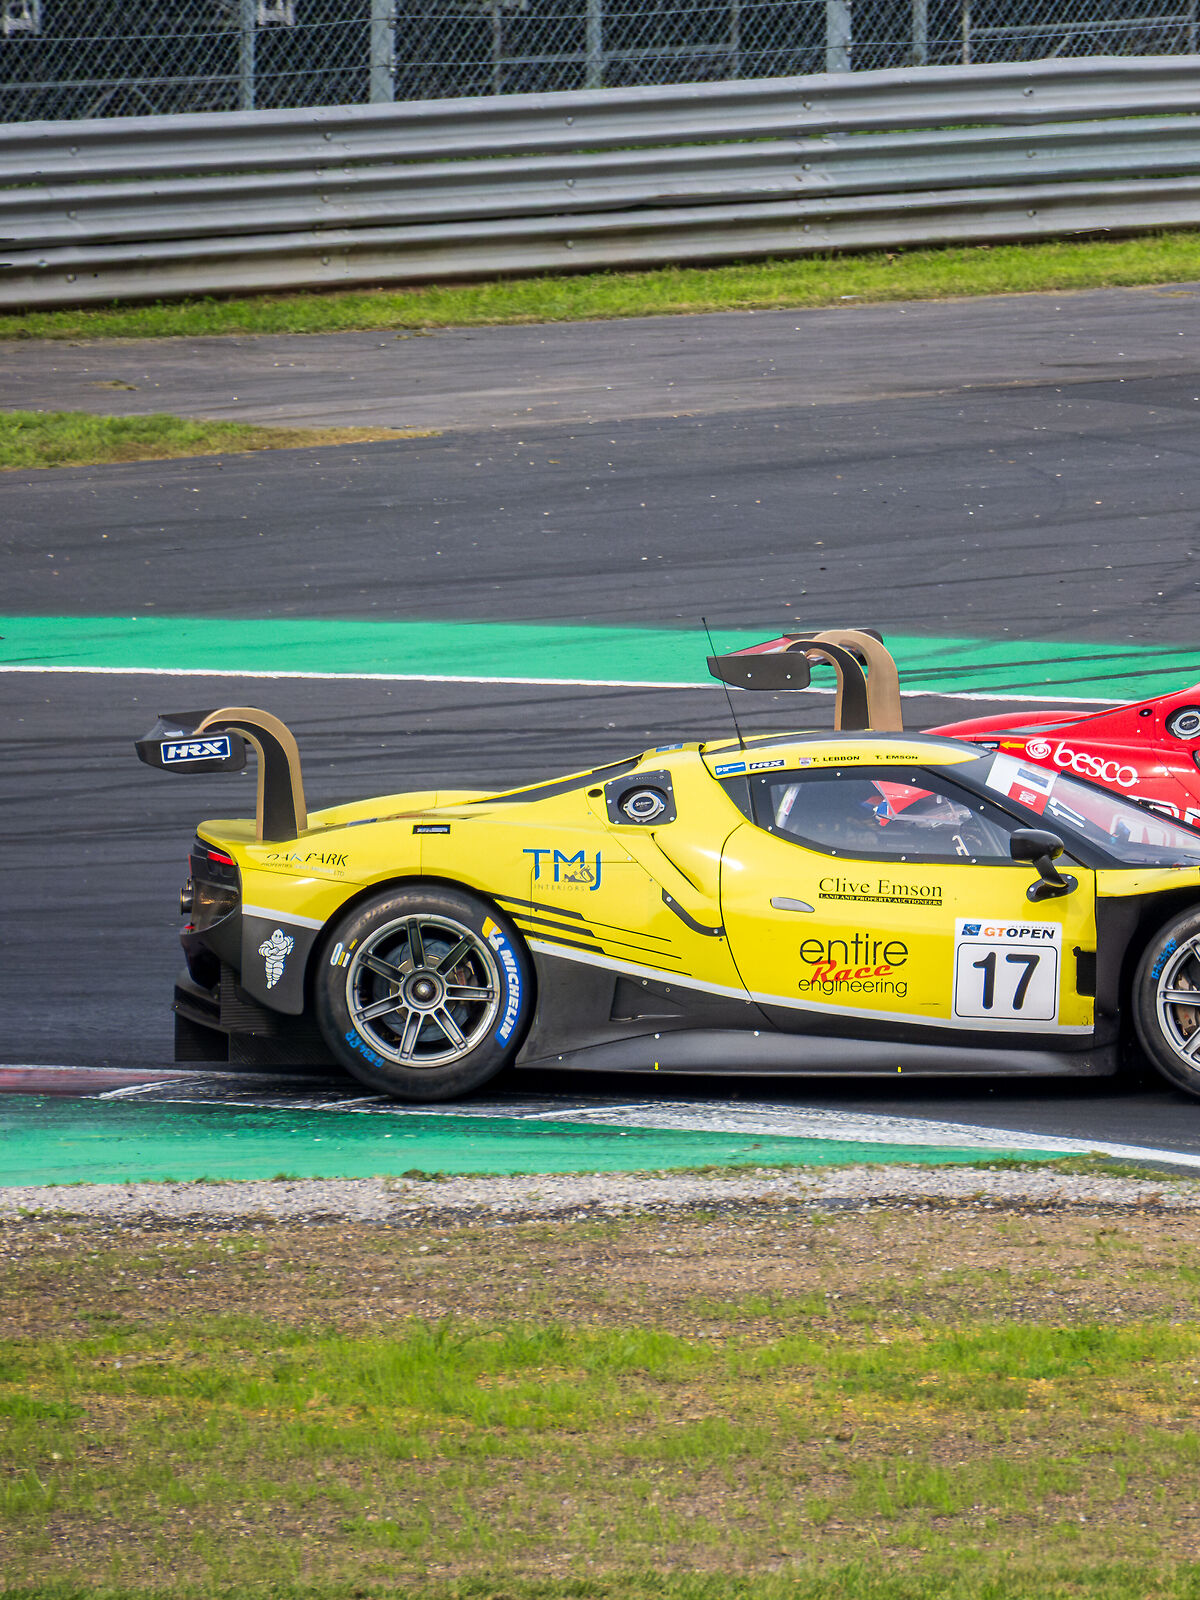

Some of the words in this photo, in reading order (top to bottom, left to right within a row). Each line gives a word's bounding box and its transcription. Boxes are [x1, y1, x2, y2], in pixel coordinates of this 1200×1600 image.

[167, 741, 224, 759] HRX
[751, 759, 784, 769] HRX
[1047, 796, 1086, 828] 17
[305, 852, 350, 867] PARK
[522, 848, 602, 892] TMJ
[819, 877, 870, 894] Clive
[878, 879, 943, 897] Emson
[856, 895, 893, 904] PROPERTY
[893, 898, 942, 906] AUCTIONEERS
[799, 932, 909, 967] entire
[798, 977, 908, 998] engineering
[972, 951, 1041, 1011] 17
[499, 949, 521, 1041] MICHELIN
